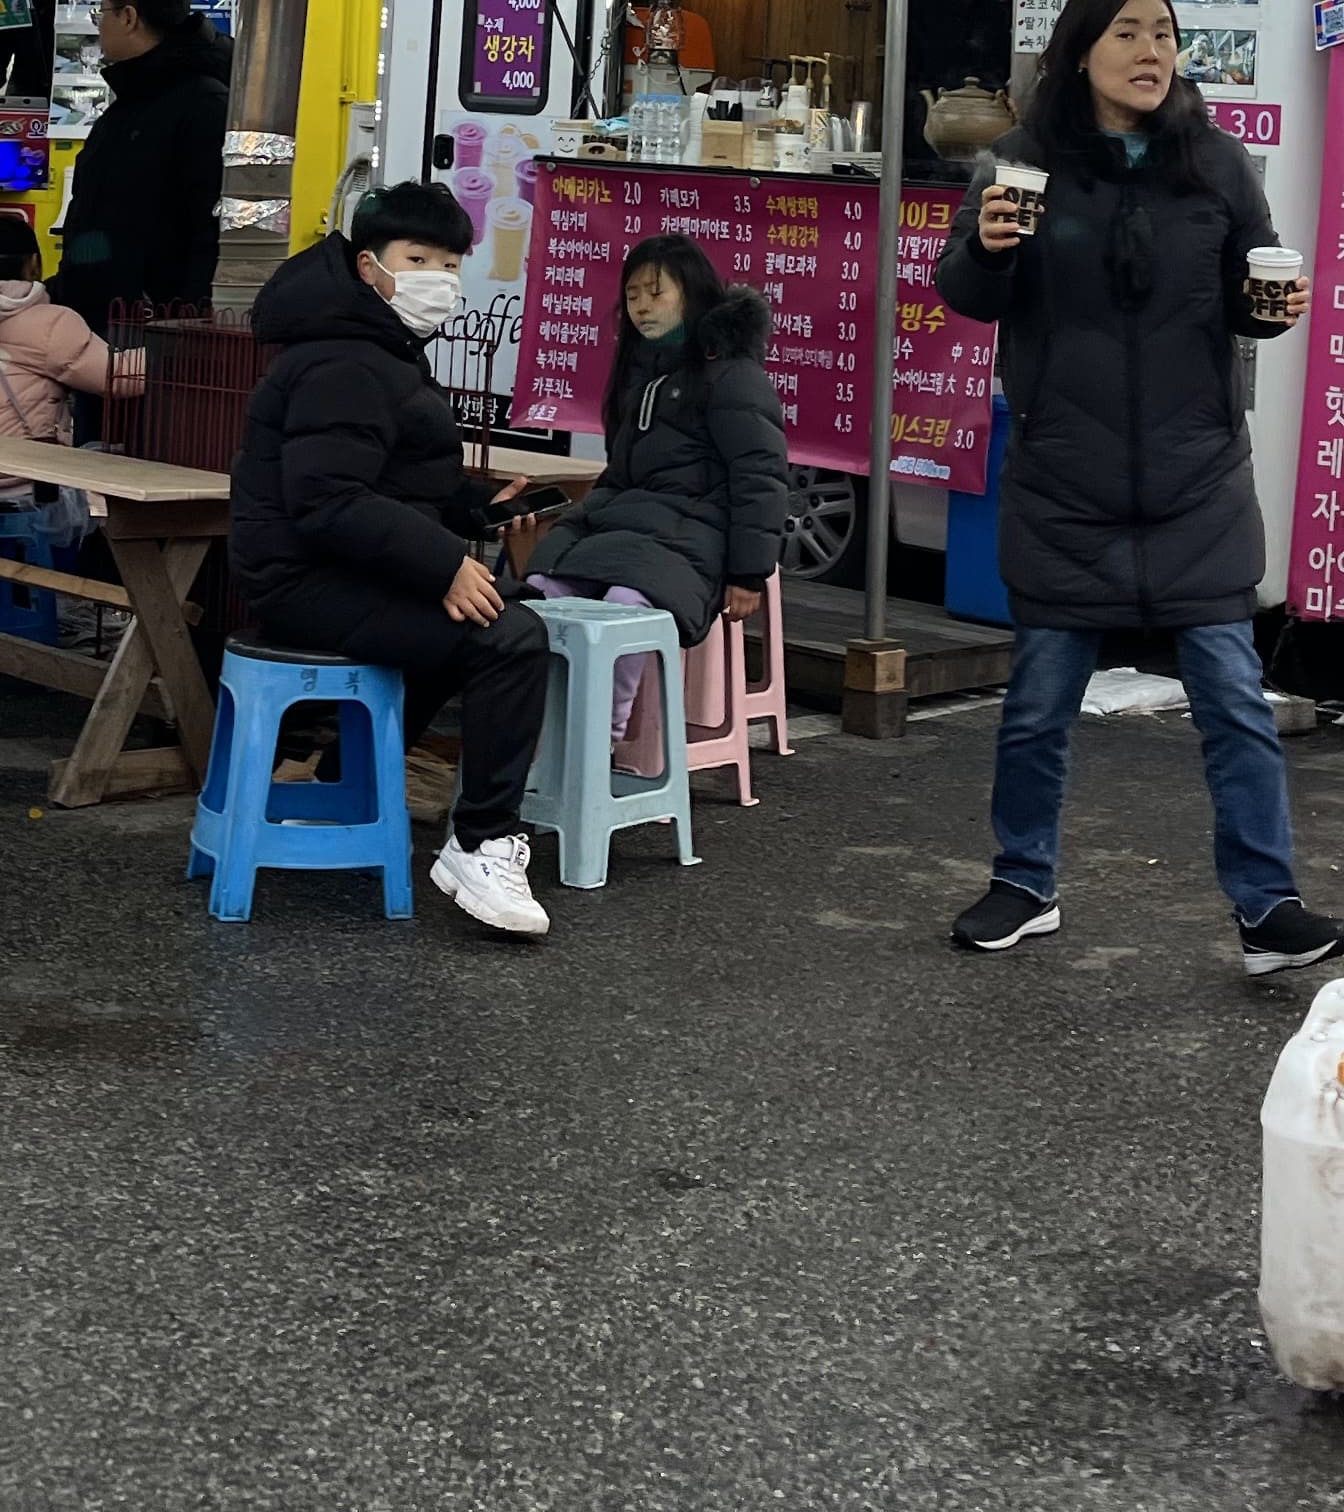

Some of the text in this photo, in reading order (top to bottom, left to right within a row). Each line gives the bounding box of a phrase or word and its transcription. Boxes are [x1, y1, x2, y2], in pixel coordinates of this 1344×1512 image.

[483, 34, 535, 63] 생강차
[501, 70, 535, 90] 4,000
[1231, 111, 1273, 139] 3.0
[552, 175, 613, 205] 아메리카노
[659, 187, 751, 213] 카페모카 3.5
[765, 195, 862, 220] 수제쌍화탕 4.0
[550, 209, 588, 233] 맥심커피
[735, 223, 752, 242] 3.5
[766, 224, 862, 250] 수제생강차 4.0
[547, 237, 611, 263] 복숭아아이스티
[733, 252, 751, 272] 3.0
[544, 264, 585, 289] 커피라떼
[765, 252, 859, 281] 꿀배모과차 3.0
[541, 292, 593, 318] 바닐라라떼
[838, 291, 857, 311] 3.0
[772, 312, 856, 341] 산사과즙 3.0
[895, 303, 946, 334] 빙수
[539, 320, 599, 347] 헤이즐넛커피
[535, 348, 578, 372] 녹차라떼
[836, 352, 855, 372] 4.0
[970, 345, 990, 366] 3.0
[531, 377, 574, 399] 카푸치노
[835, 382, 854, 402] 3.5
[964, 376, 986, 398] 5.0
[834, 413, 852, 433] 4.5
[890, 412, 975, 450] 이스크림 3.0
